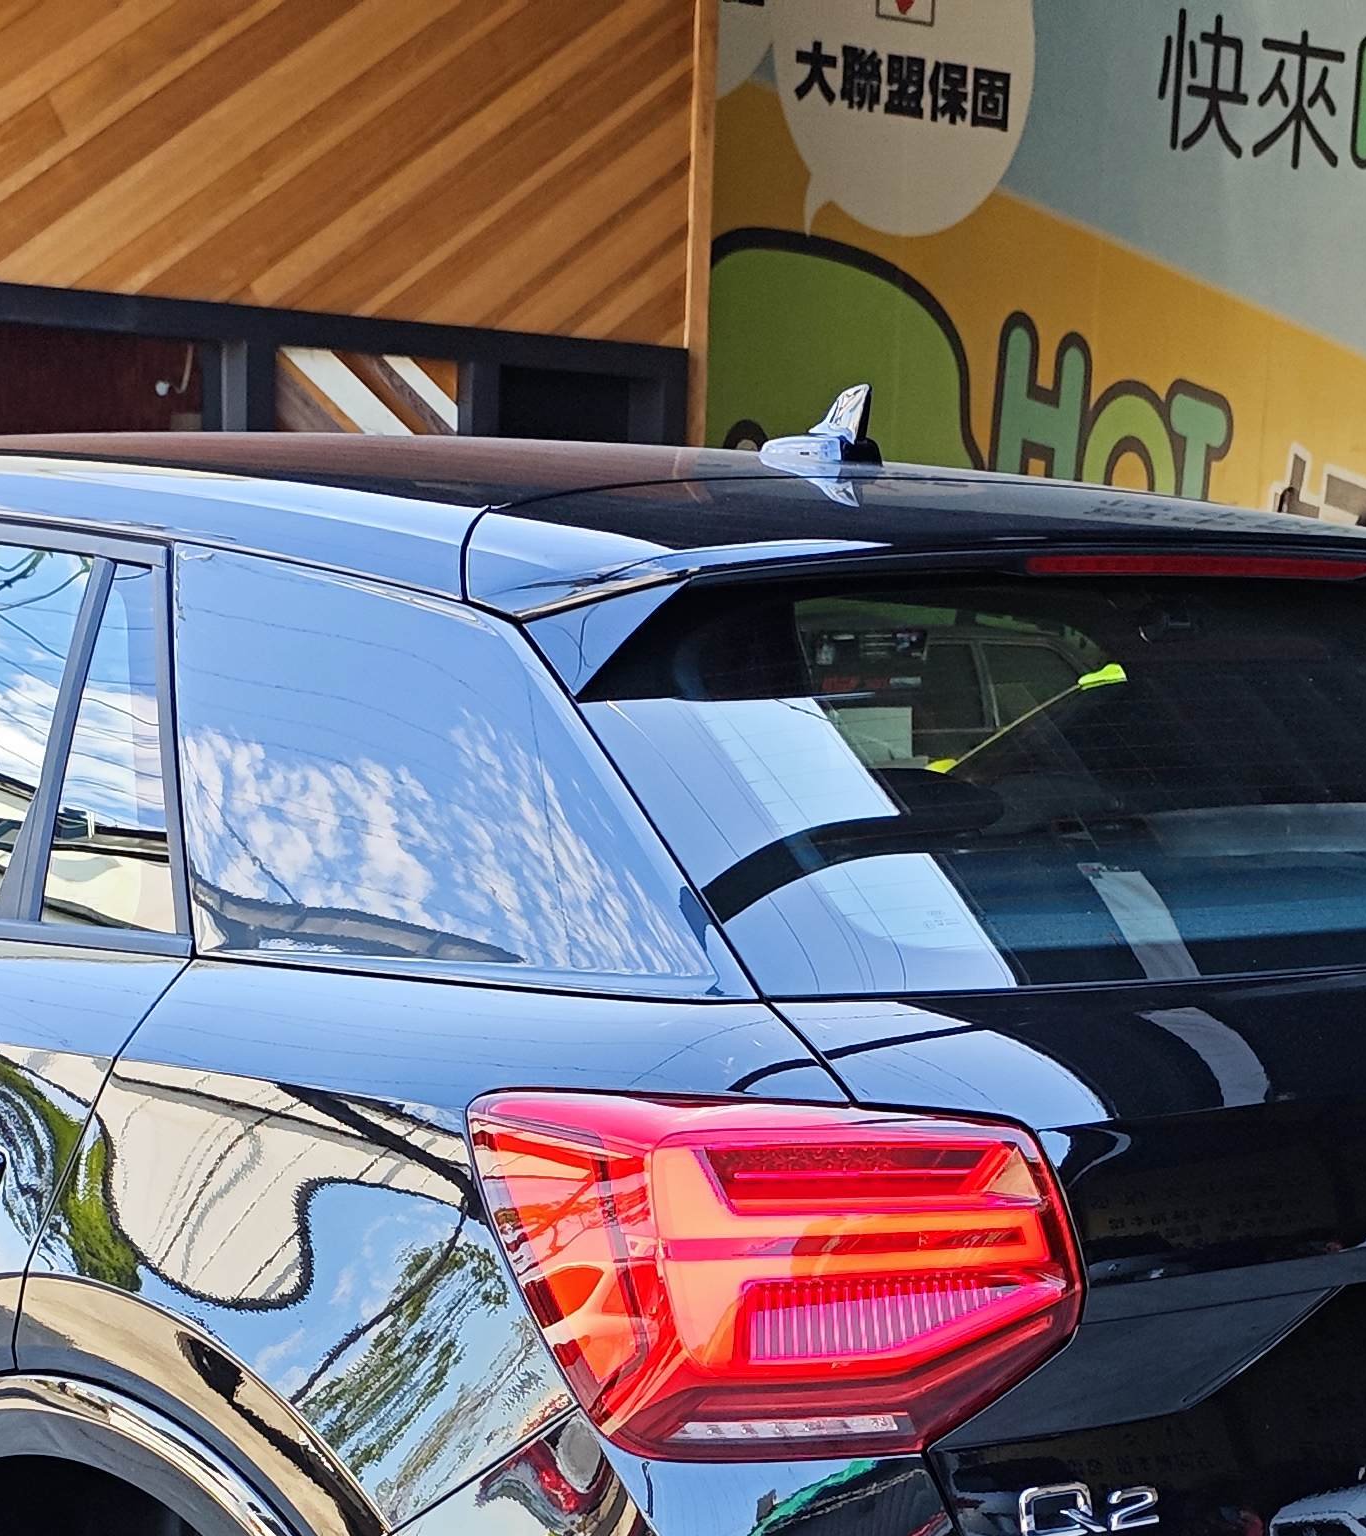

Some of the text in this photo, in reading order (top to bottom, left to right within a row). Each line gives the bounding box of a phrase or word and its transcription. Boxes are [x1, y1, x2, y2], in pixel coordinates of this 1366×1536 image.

[794, 40, 1012, 132] 大聯盟保固
[988, 311, 1233, 500] HOT
